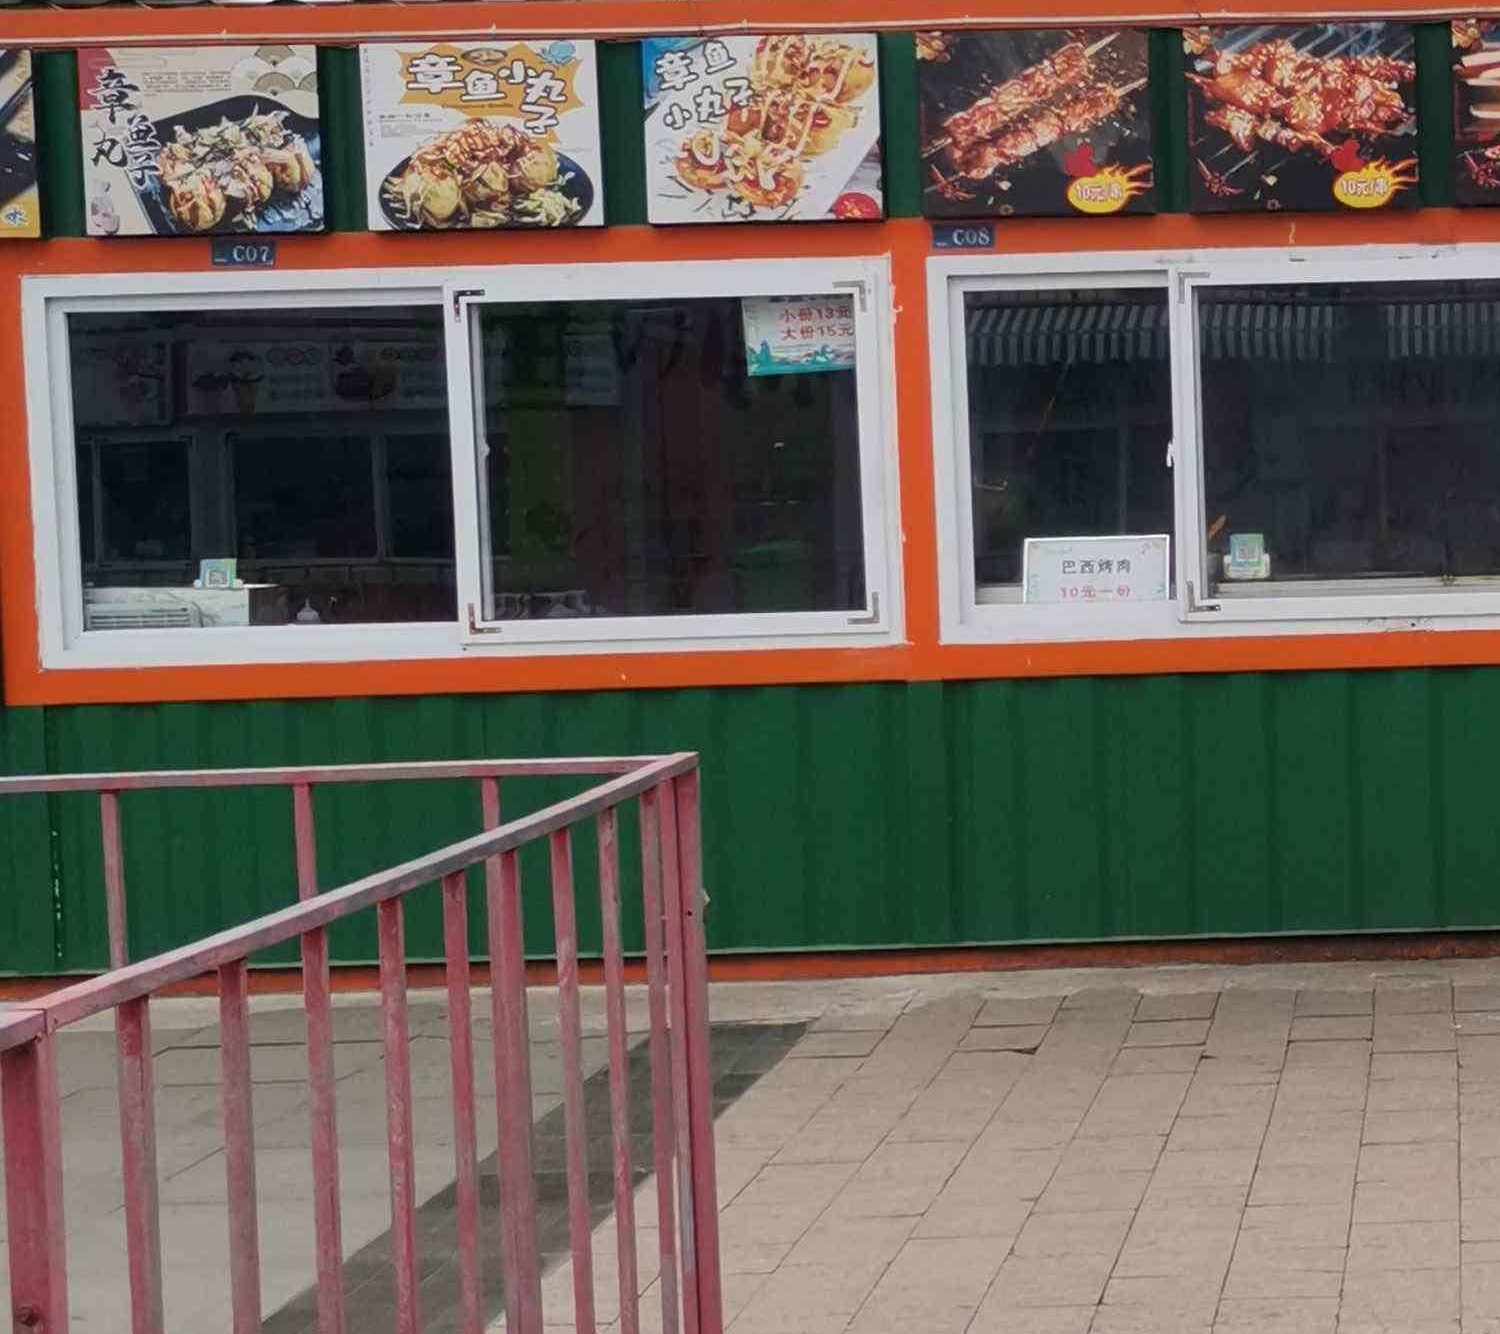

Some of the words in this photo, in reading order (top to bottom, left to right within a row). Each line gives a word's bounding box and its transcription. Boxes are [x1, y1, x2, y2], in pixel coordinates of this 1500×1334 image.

[951, 225, 992, 247] C08
[232, 245, 270, 263] C07
[1061, 558, 1131, 575] 巴西烤肉
